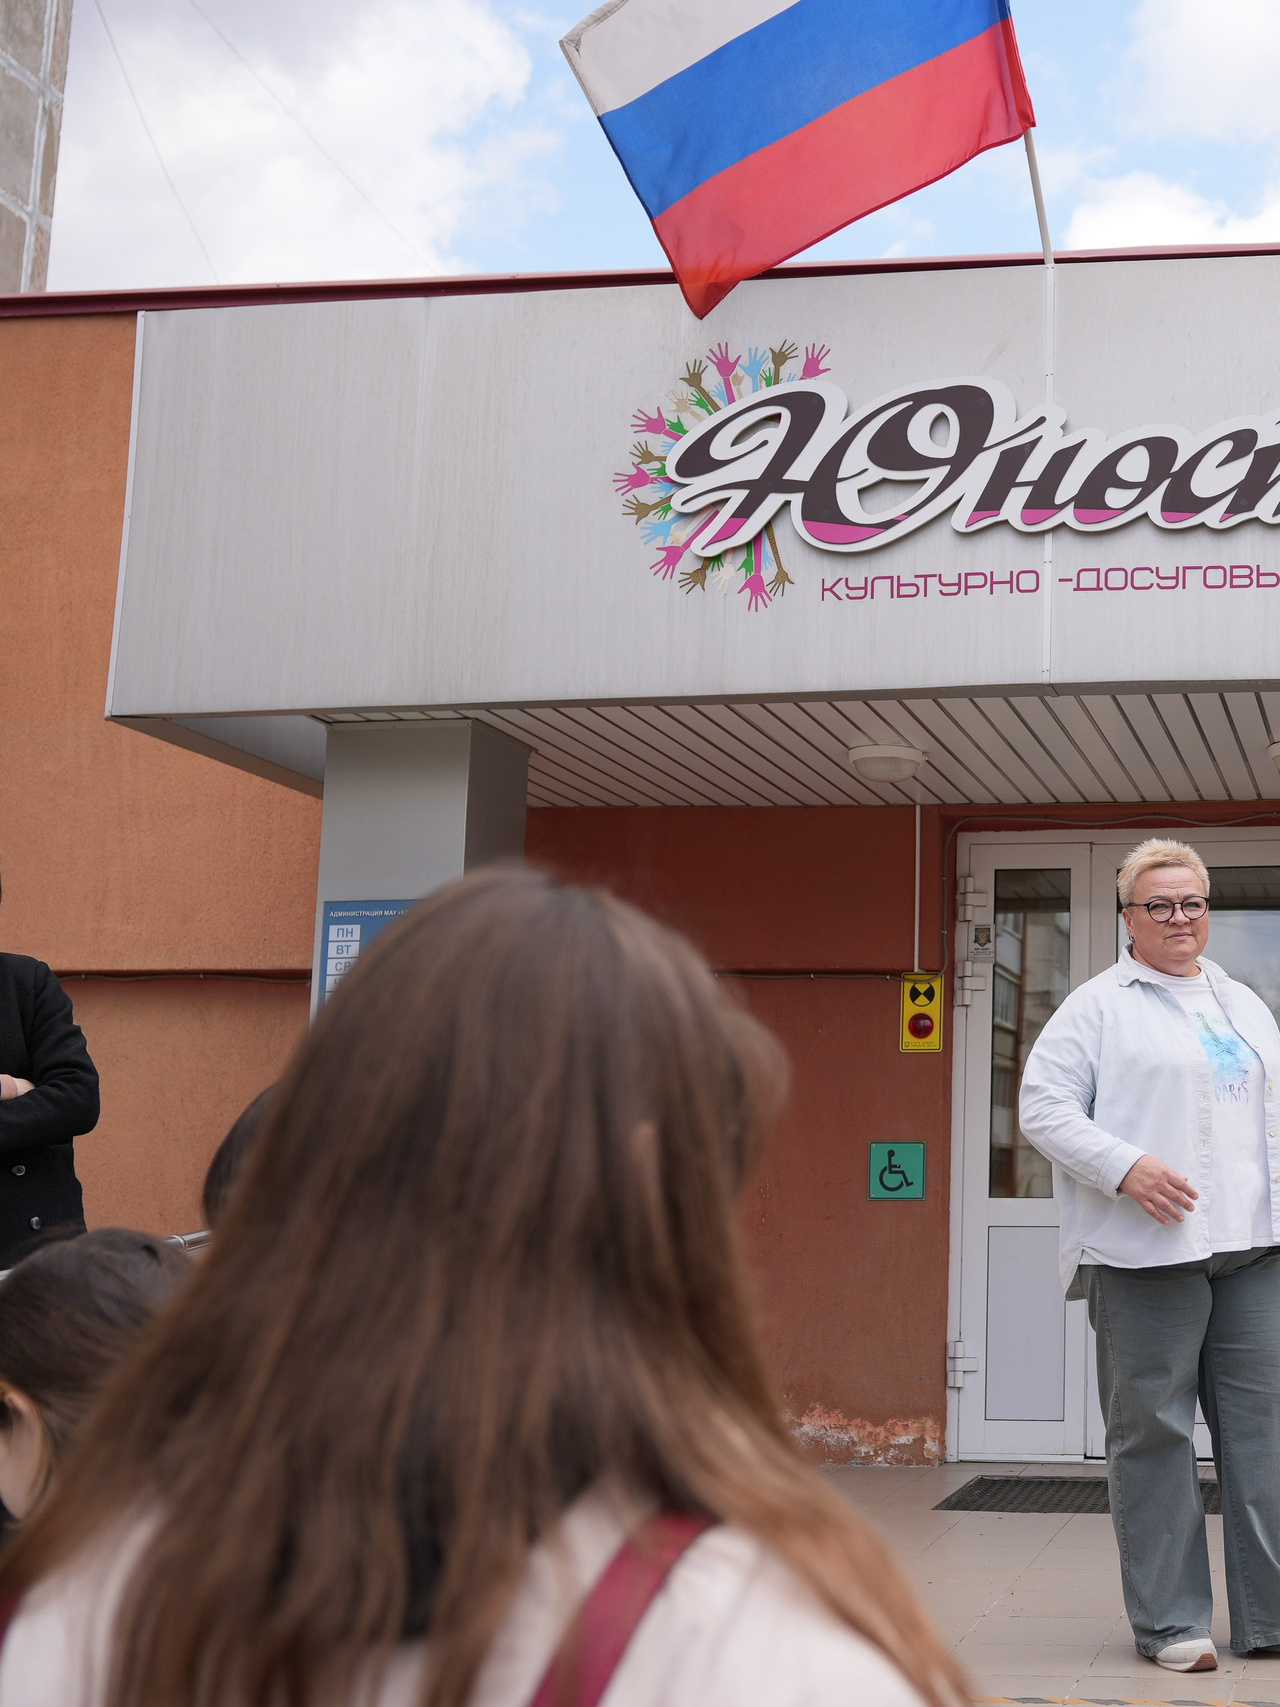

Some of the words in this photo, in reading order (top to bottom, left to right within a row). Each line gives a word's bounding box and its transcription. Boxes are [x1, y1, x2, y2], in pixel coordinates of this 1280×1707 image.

[820, 569, 1041, 601] КУЛЬТУРНО
[329, 910, 383, 918] АДМИНИСТРАЦИЯ
[337, 928, 354, 938] ПН
[336, 944, 352, 955] ВТ
[334, 961, 352, 972] СР
